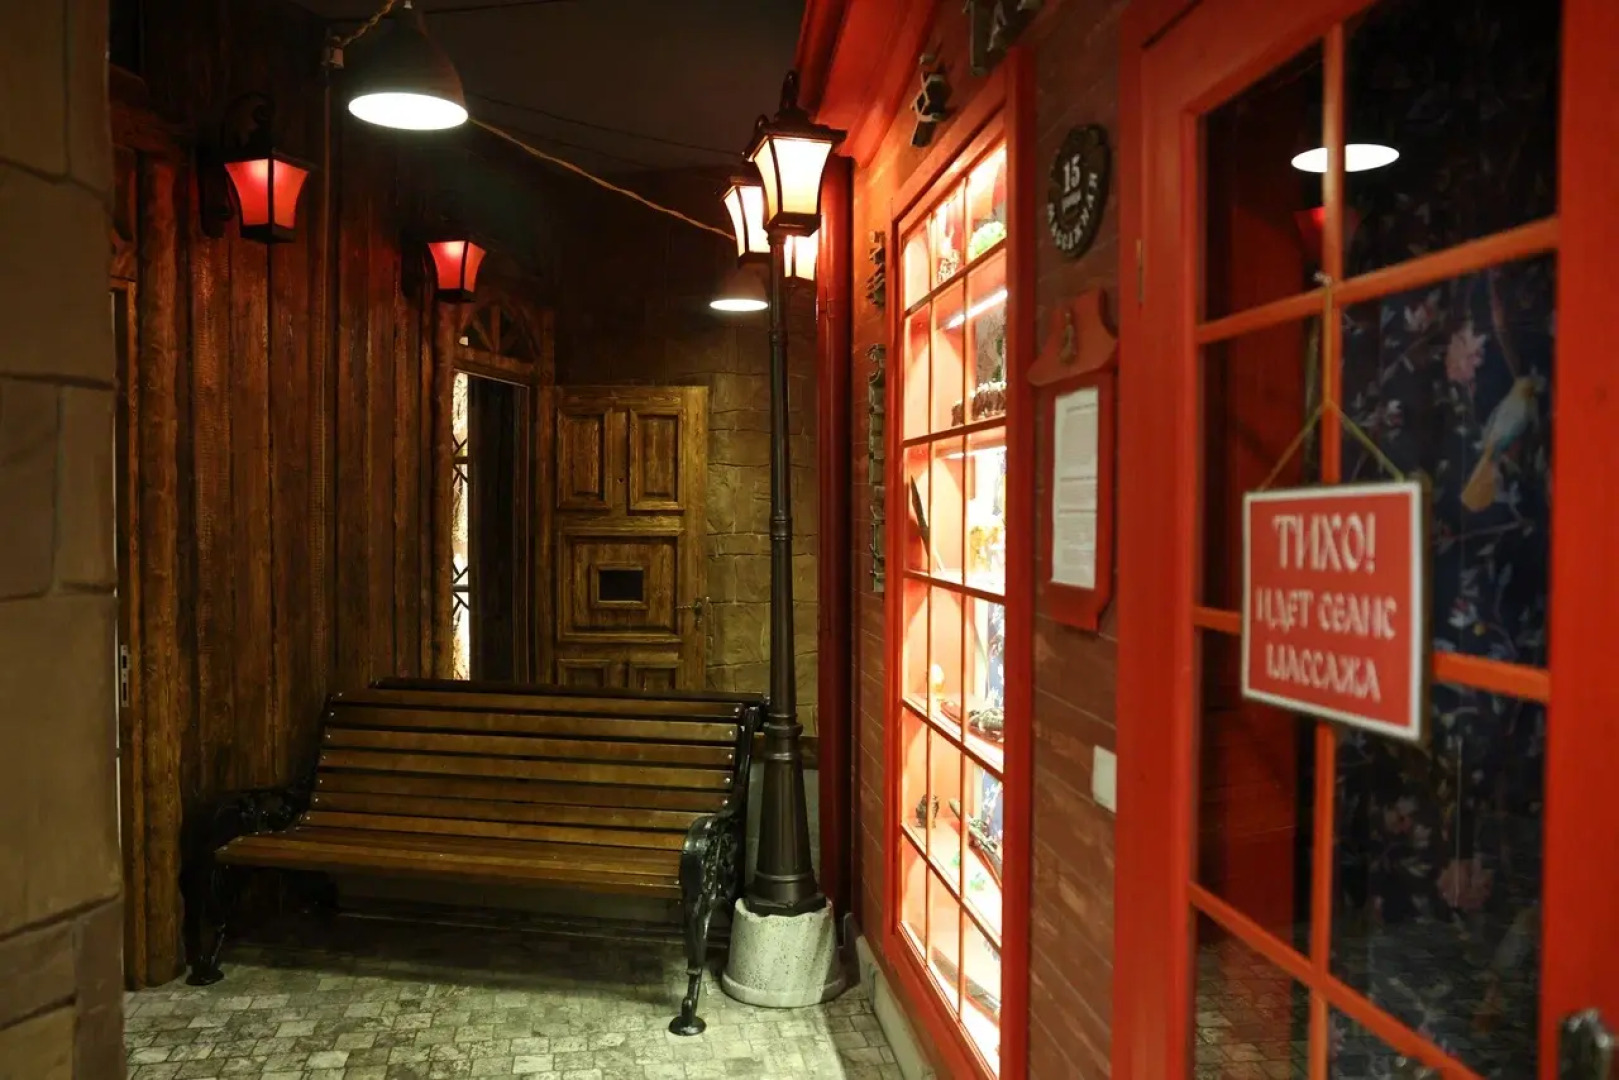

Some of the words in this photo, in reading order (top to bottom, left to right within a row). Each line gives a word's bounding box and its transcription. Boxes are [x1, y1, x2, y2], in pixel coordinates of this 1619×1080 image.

[1063, 153, 1081, 194] 15
[1272, 512, 1376, 575] ТИХО!
[1317, 591, 1397, 641] СЕАНС
[1265, 643, 1382, 704] МАССАЖА
